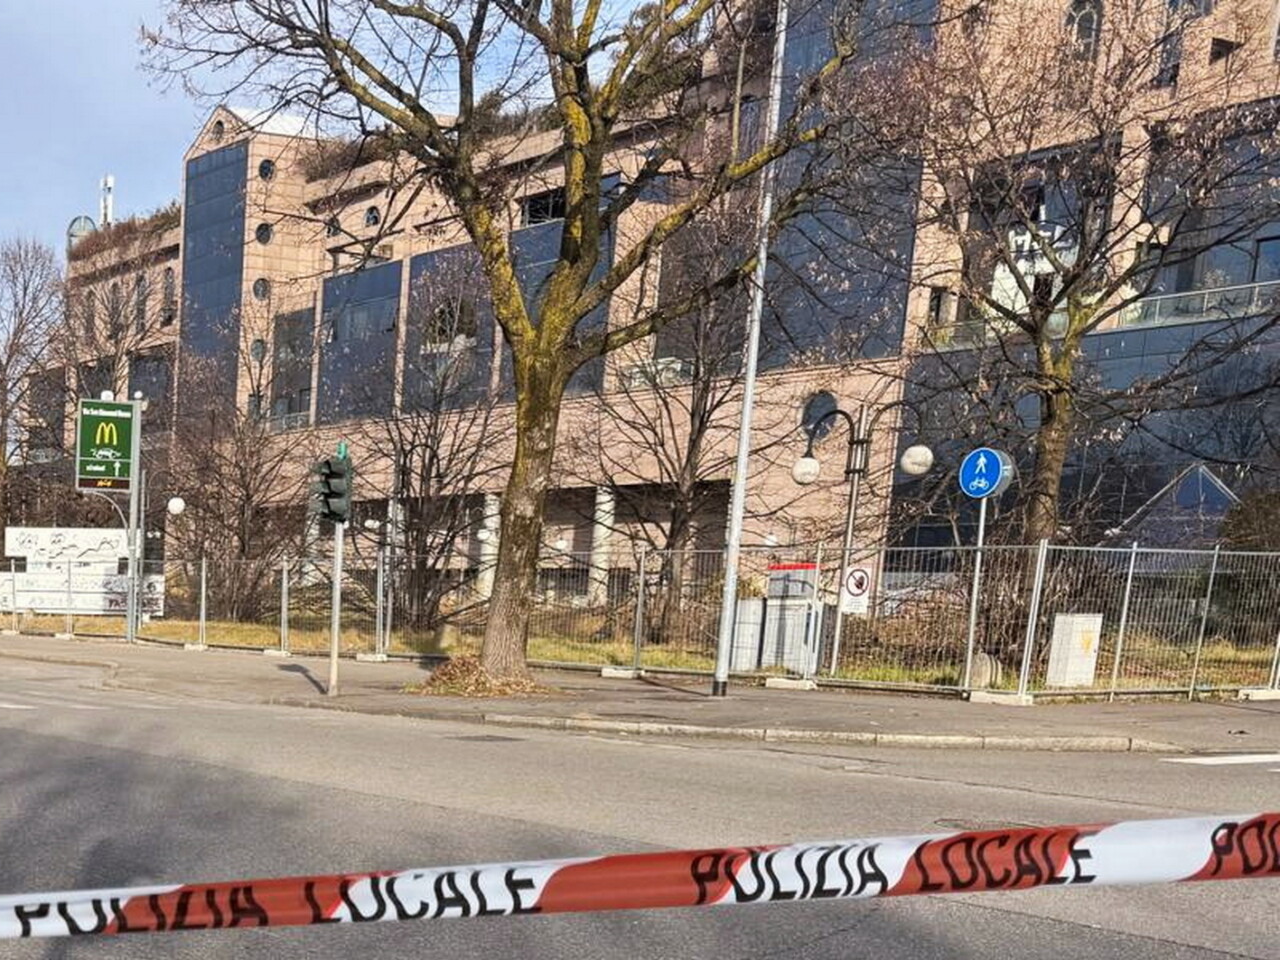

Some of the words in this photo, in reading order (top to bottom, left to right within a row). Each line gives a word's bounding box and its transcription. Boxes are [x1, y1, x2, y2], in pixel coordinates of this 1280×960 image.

[14, 884, 268, 938] POLIZIA
[303, 867, 543, 924] LOCALE
[691, 843, 890, 906] POLIZIA
[914, 827, 1097, 892] LOCALE
